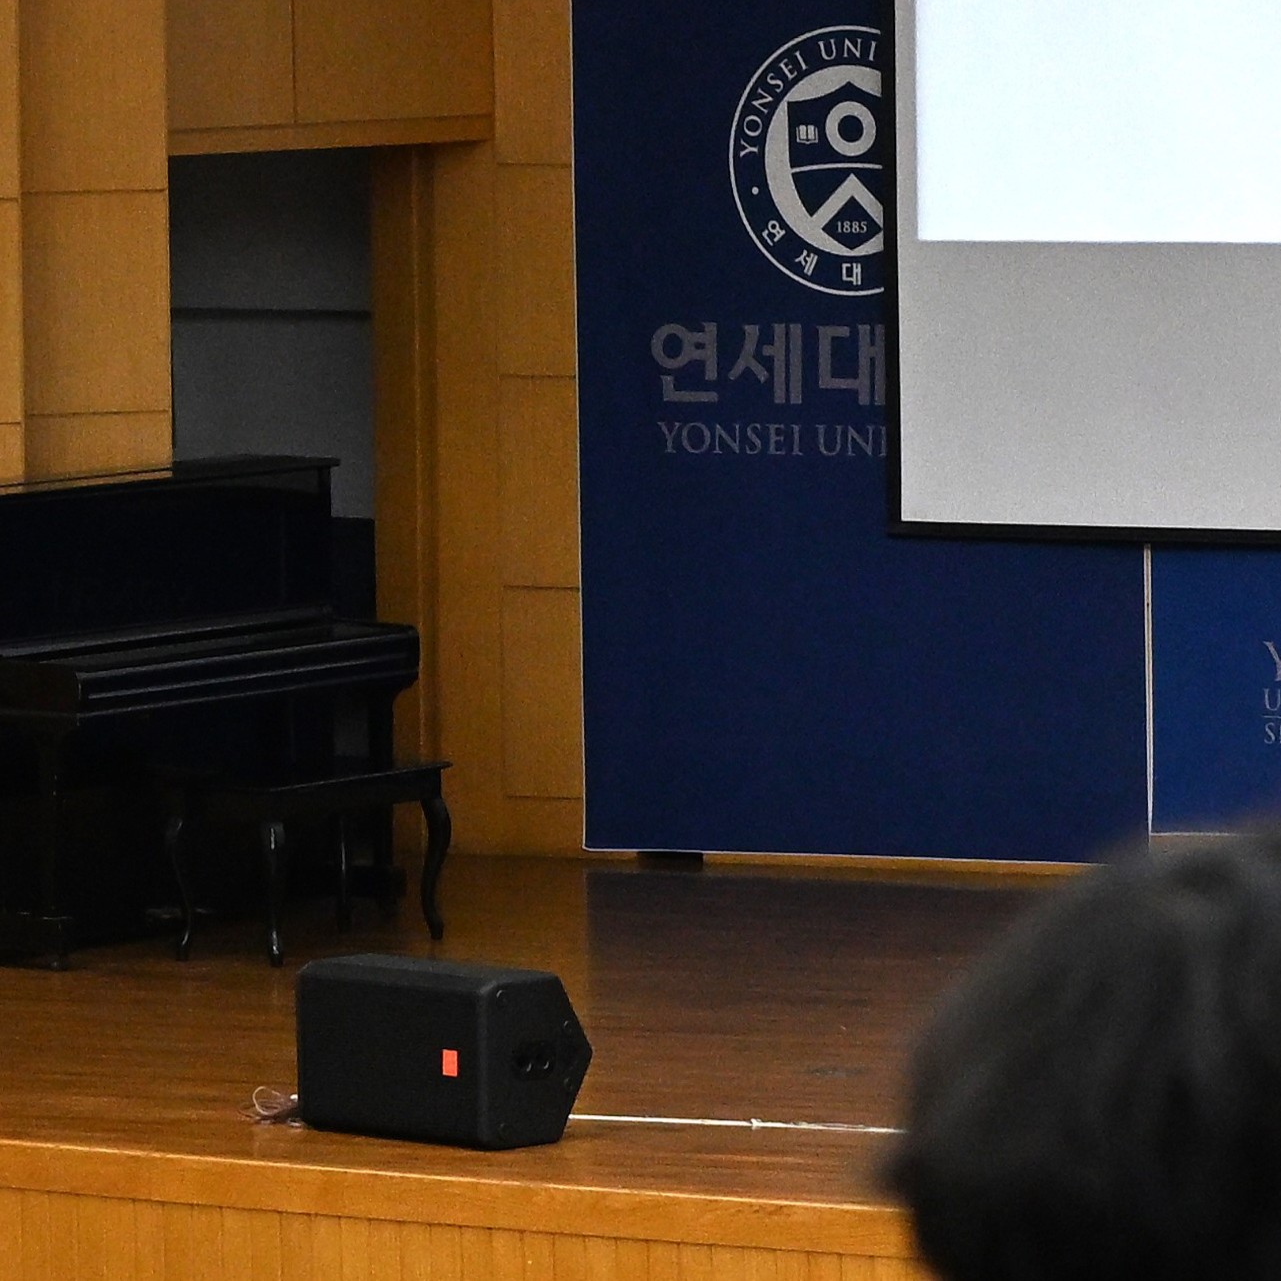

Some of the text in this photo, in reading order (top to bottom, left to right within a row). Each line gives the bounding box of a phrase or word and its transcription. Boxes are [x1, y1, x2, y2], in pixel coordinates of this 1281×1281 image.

[739, 49, 807, 158] YONSEI
[836, 221, 868, 234] 1885
[657, 421, 803, 455] YONSEI
